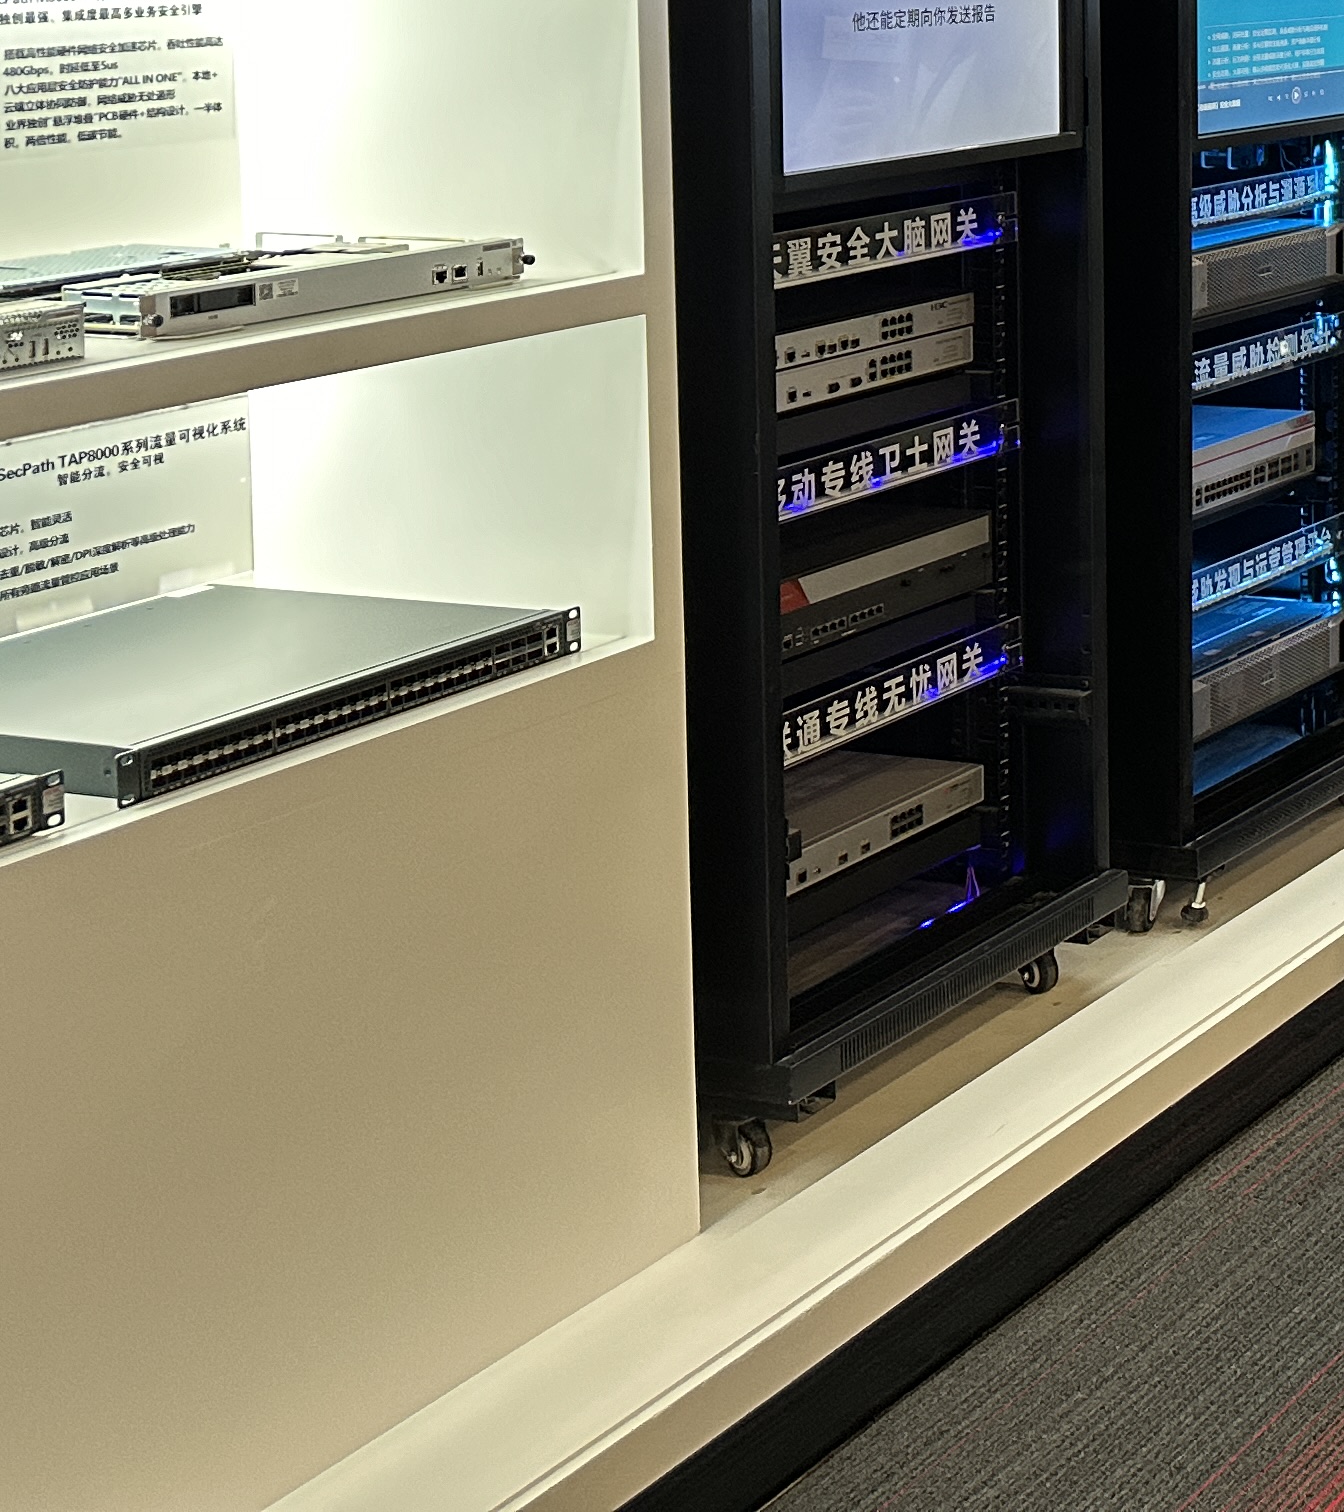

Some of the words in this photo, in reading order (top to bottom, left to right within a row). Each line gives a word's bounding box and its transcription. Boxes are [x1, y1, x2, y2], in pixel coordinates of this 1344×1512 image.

[852, 4, 995, 32] 他还能定期向你发送报告
[58, 416, 247, 469] TAP8000系列流量可视化系统
